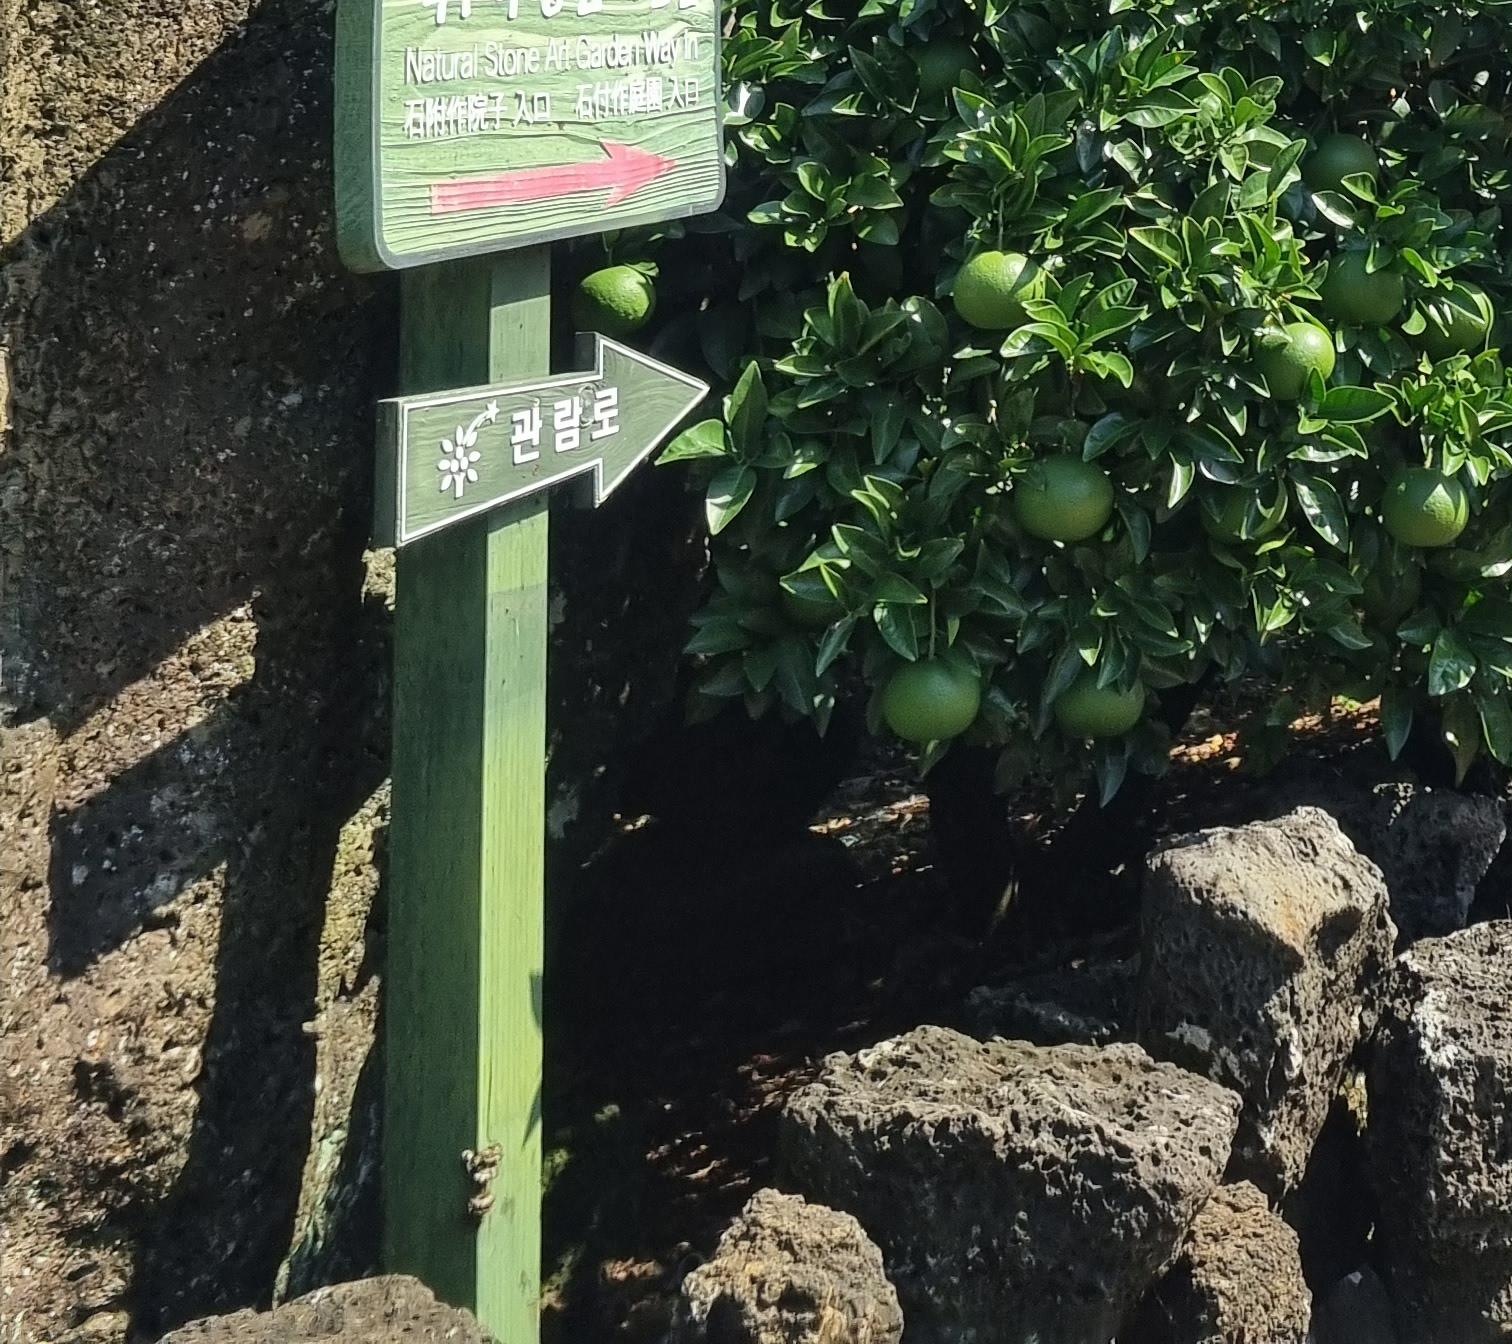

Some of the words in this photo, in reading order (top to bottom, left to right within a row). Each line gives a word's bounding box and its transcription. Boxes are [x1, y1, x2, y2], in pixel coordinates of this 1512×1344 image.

[405, 45, 478, 84] Natural
[484, 41, 541, 76] Stone
[545, 37, 571, 71] Art
[575, 34, 642, 69] Garden
[643, 31, 681, 69] Way
[684, 29, 698, 60] in
[512, 90, 551, 127] 入口
[667, 75, 699, 111] 入口
[511, 387, 619, 464] 관람로
